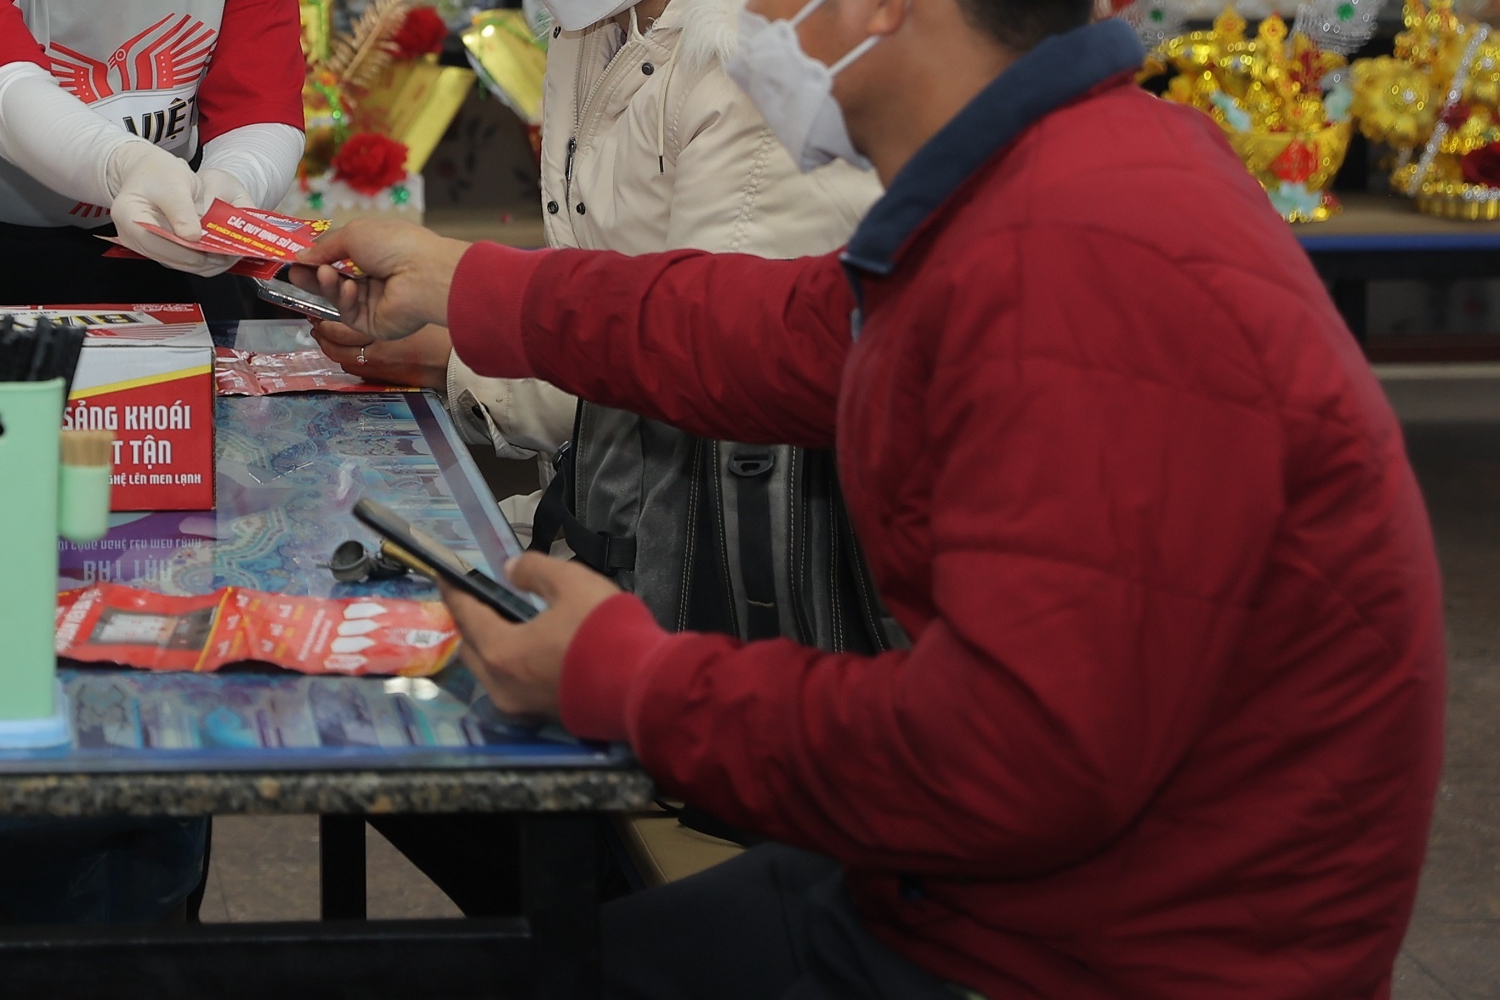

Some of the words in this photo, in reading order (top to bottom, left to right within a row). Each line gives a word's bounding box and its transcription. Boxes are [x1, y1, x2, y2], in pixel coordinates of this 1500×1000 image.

[61, 400, 118, 431] SẢNG
[124, 400, 191, 431] KHOÁI
[129, 434, 172, 470] TẬN
[150, 473, 173, 485] MEN
[174, 473, 202, 487] LẠNH
